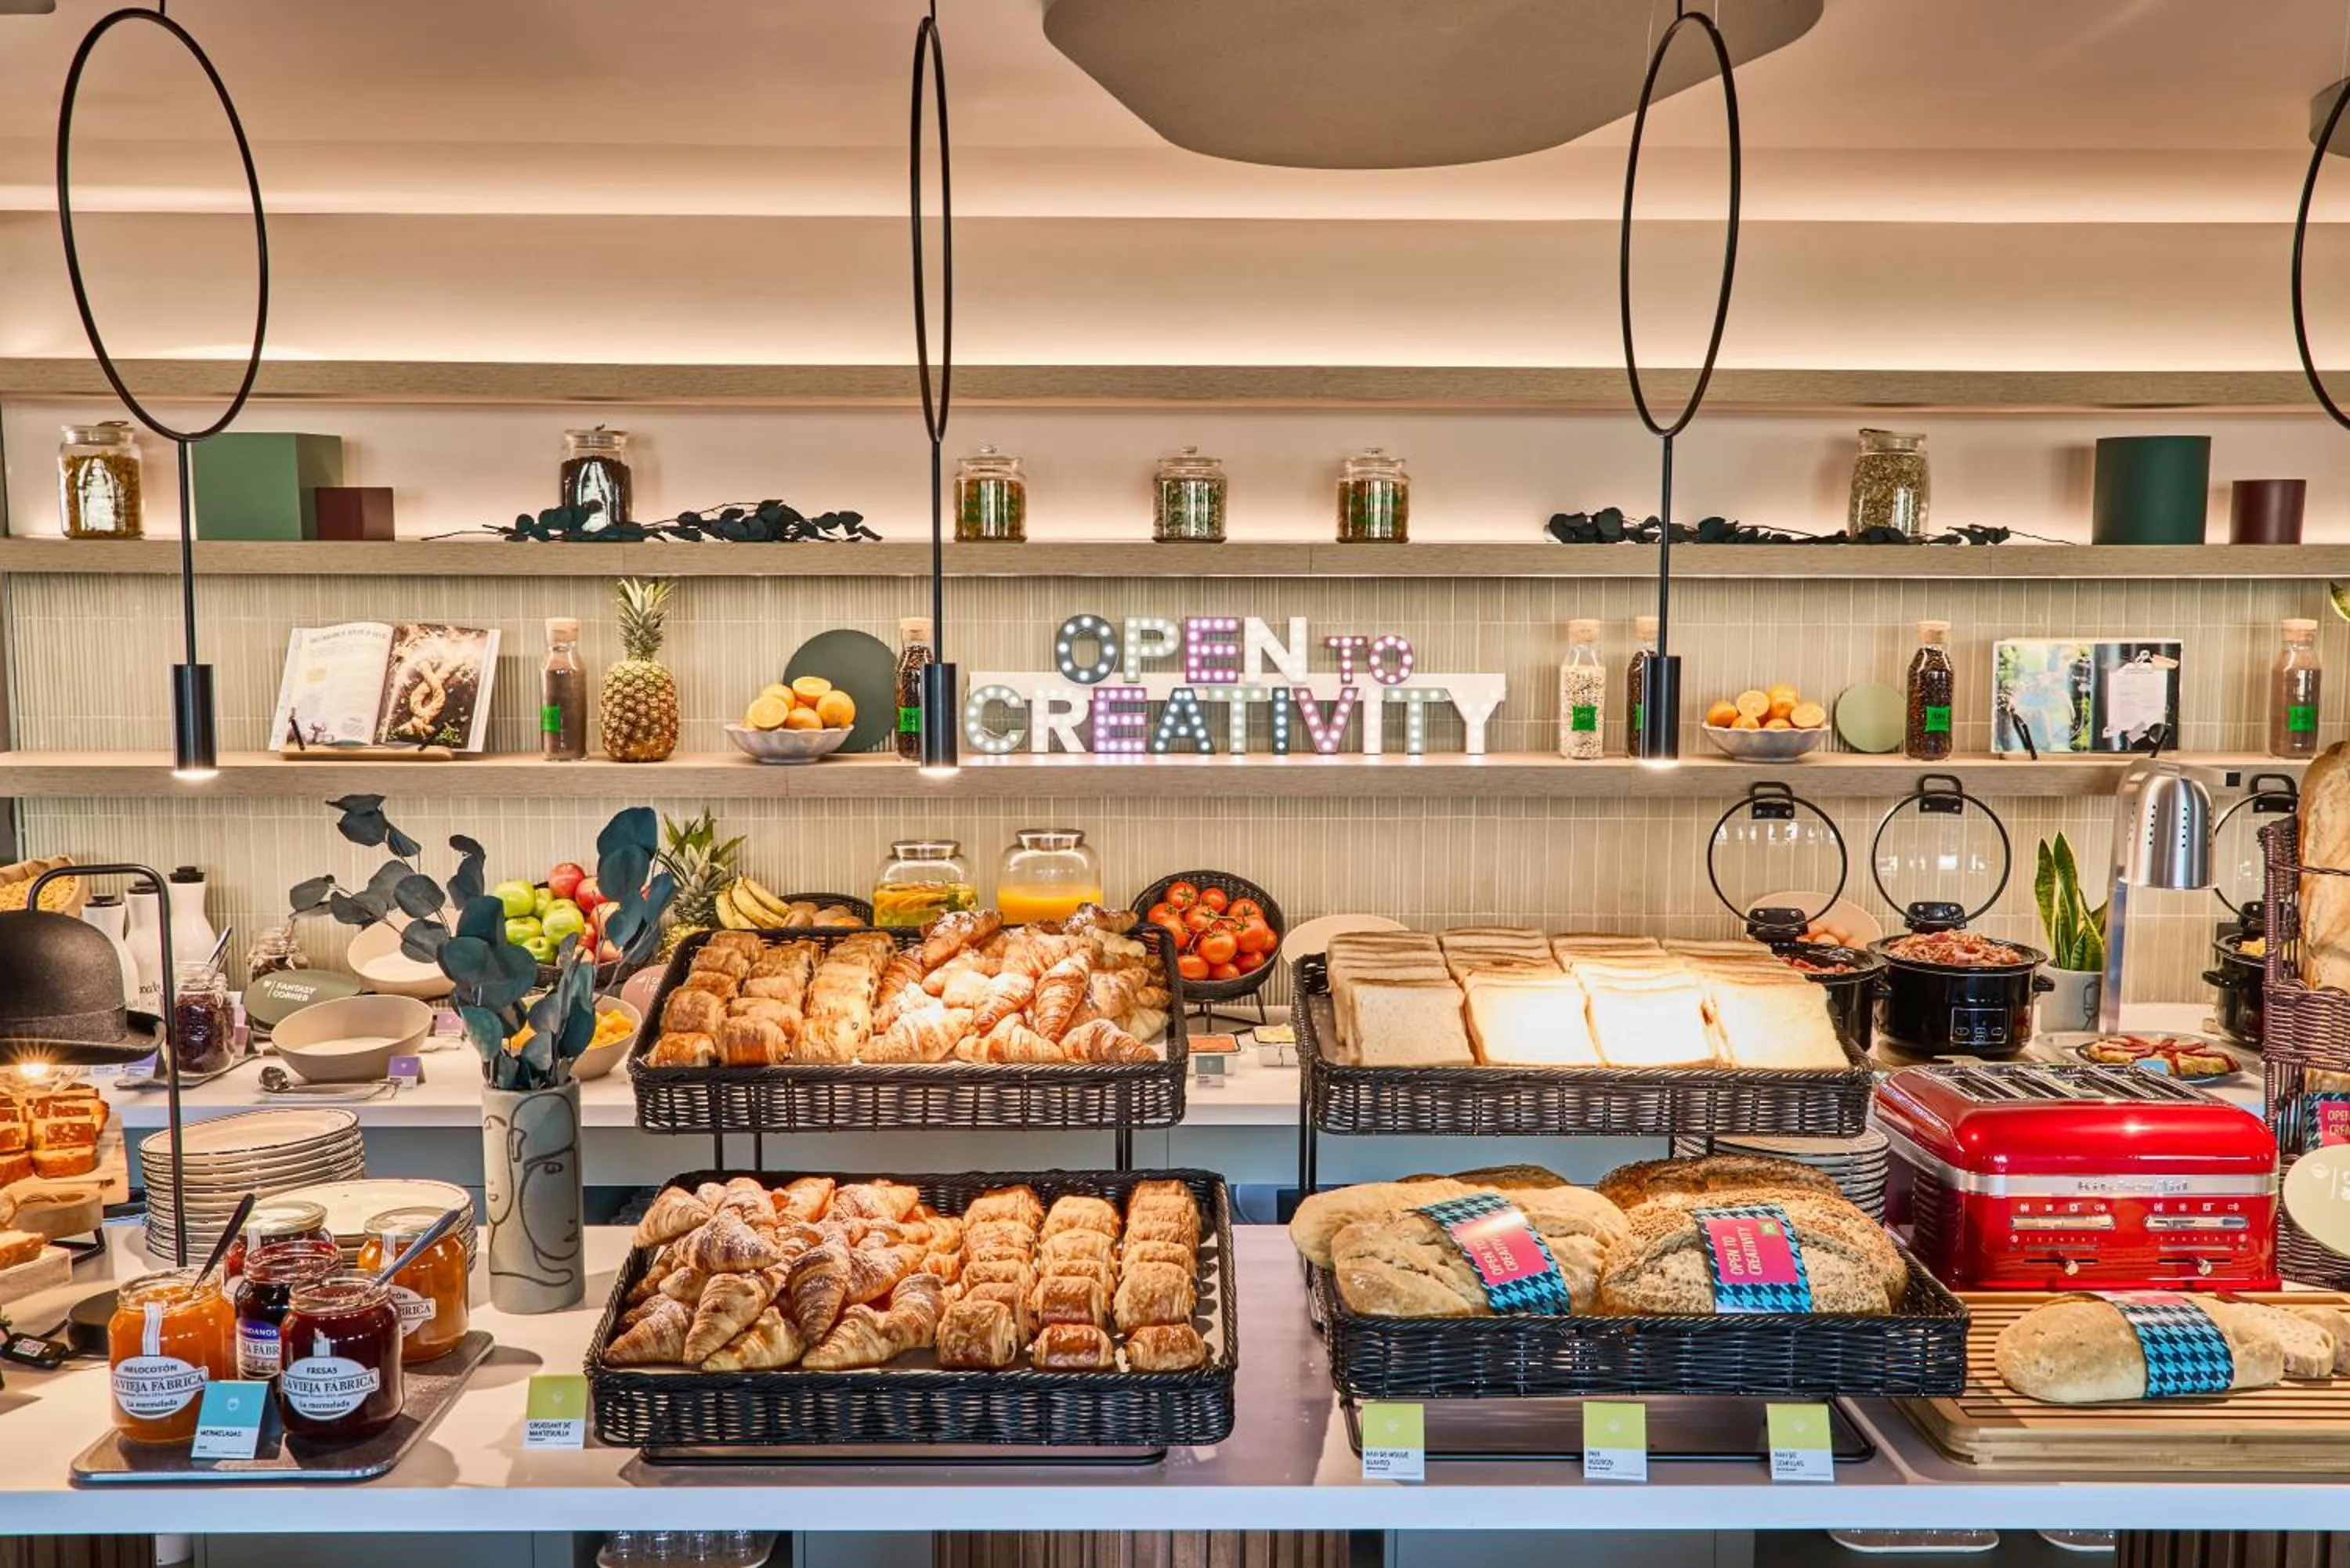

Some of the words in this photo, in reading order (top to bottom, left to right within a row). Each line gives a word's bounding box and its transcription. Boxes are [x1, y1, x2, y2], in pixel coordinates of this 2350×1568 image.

[1054, 614, 1307, 684] OPEN
[1324, 635, 1415, 685] TO
[964, 684, 1505, 755] CREATIVITY
[273, 990, 309, 1002] CORNER
[277, 982, 316, 995] FANTASY
[1722, 1236, 1738, 1248] TO
[1736, 1227, 1763, 1276] CREATIVITY
[1481, 1252, 1504, 1276] OPEN
[1726, 1250, 1744, 1276] OPEN
[402, 1304, 431, 1316] BRICA
[124, 1364, 178, 1374] MELOCOTÓN
[121, 1381, 148, 1393] VIEJA
[151, 1374, 204, 1392] FÁBRICA
[292, 1379, 320, 1393] VIEJA
[325, 1375, 376, 1393] FÁBRICA
